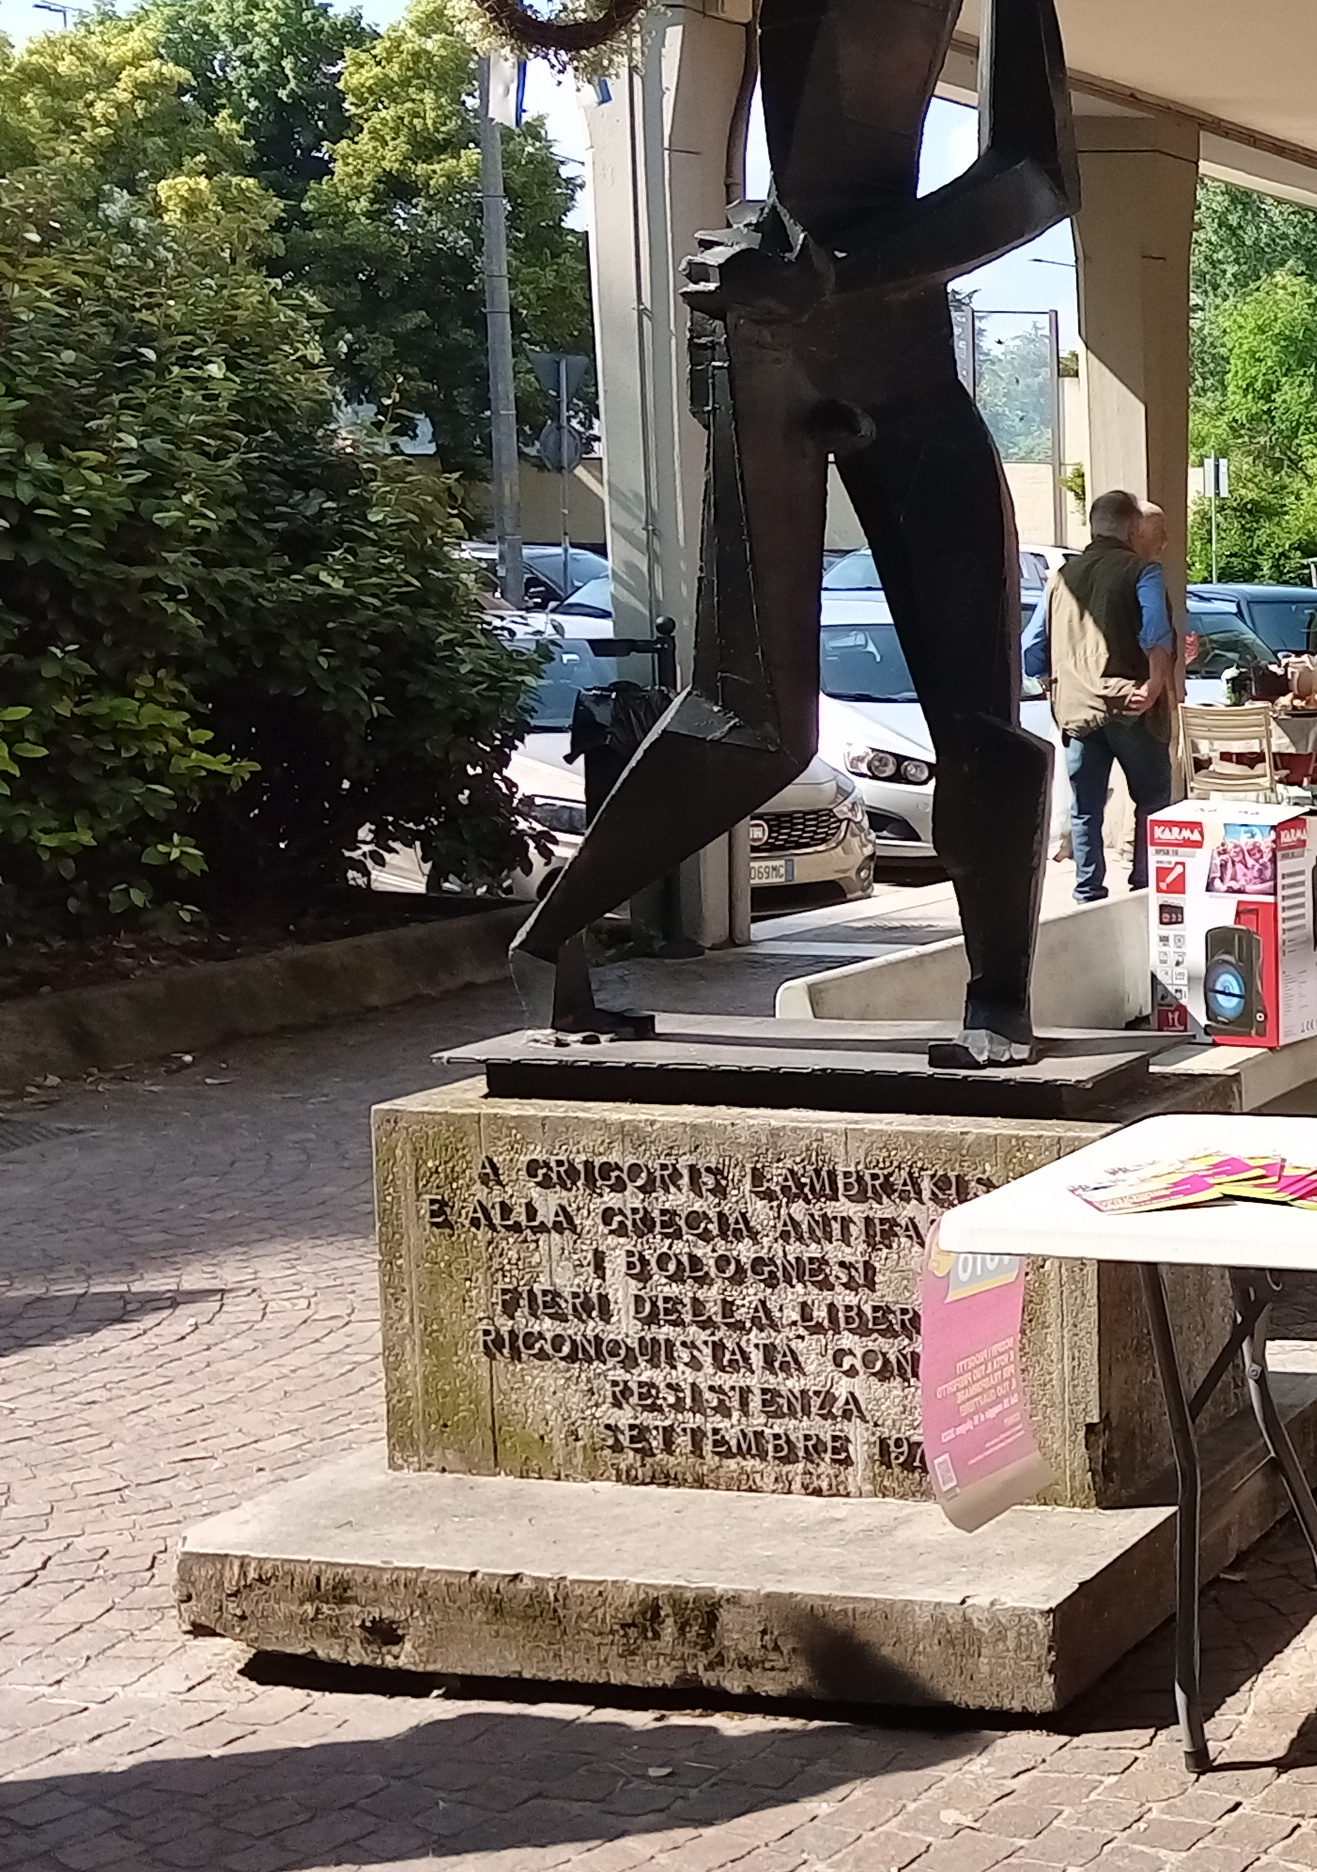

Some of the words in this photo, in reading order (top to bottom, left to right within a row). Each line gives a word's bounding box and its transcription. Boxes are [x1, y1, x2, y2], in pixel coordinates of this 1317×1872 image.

[1154, 825, 1202, 841] KARMA
[478, 1155, 502, 1187] A
[524, 1158, 727, 1197] GRIGORIS
[422, 1194, 453, 1232] E
[469, 1198, 577, 1236] ALLA
[601, 1204, 752, 1246] GRECIA
[777, 1212, 938, 1250] ANTIFA
[624, 1247, 876, 1292] BOLOGNESI
[493, 1285, 613, 1323] FIERI
[631, 1292, 779, 1332] DELLA
[796, 1299, 921, 1338] LIBER
[477, 1325, 806, 1377] RICONQUISTATA
[831, 1347, 921, 1383] CON
[606, 1377, 870, 1424] RESISTENZA
[600, 1422, 854, 1468] SETTEMBRE
[876, 1434, 927, 1472] 197
